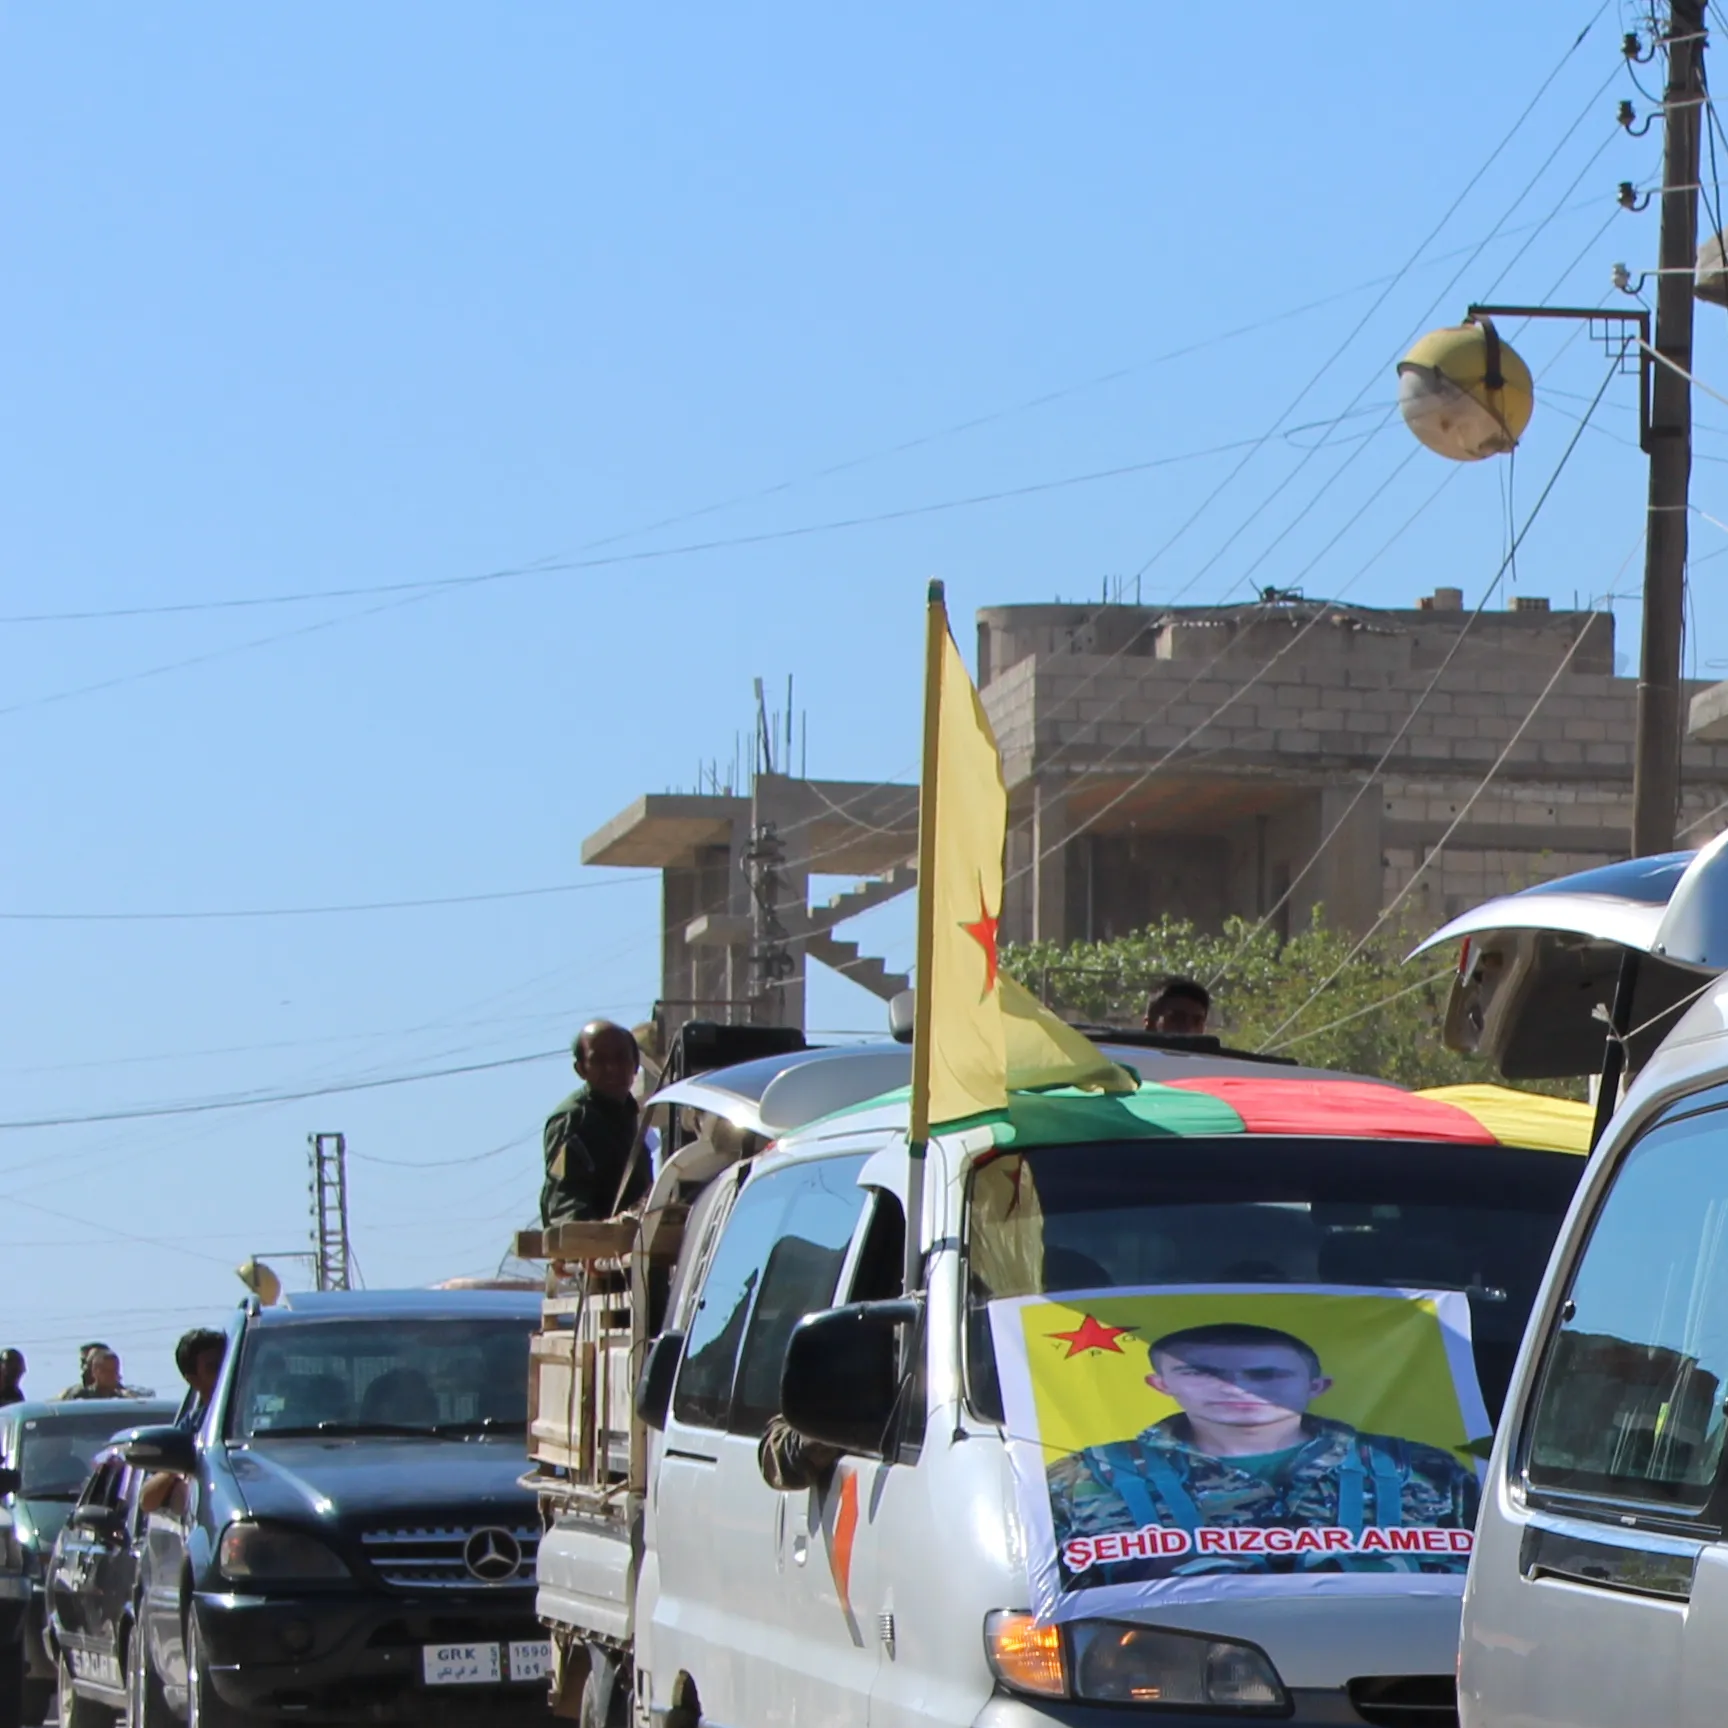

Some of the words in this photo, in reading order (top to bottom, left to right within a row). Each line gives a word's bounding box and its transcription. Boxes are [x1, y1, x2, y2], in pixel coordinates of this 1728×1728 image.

[1065, 1524, 1187, 1568] ŞEHÎD
[1198, 1527, 1349, 1553] RIZGAR
[1361, 1528, 1474, 1553] AMED
[437, 1648, 476, 1661] GRK
[514, 1644, 552, 1658] 1590
